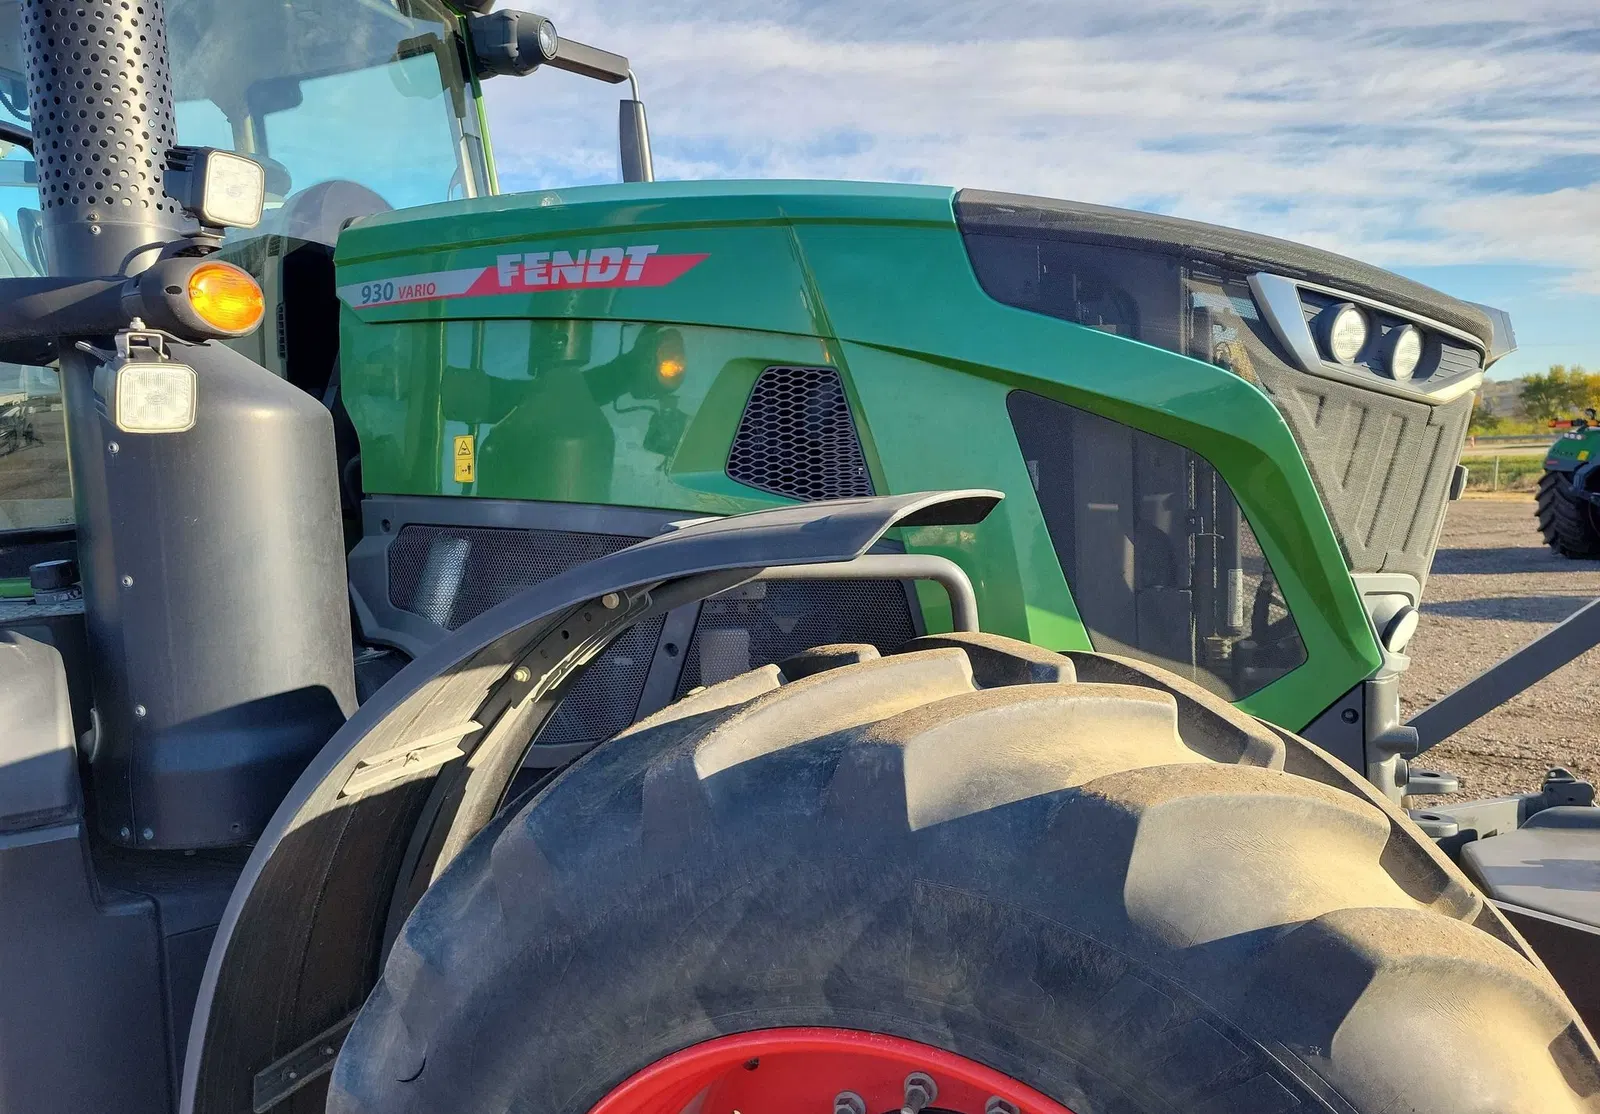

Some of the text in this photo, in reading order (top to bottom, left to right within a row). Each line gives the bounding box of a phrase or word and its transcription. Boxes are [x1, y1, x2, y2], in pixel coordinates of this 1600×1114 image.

[496, 244, 659, 288] FENDT
[361, 281, 436, 304] 930 VARIO
